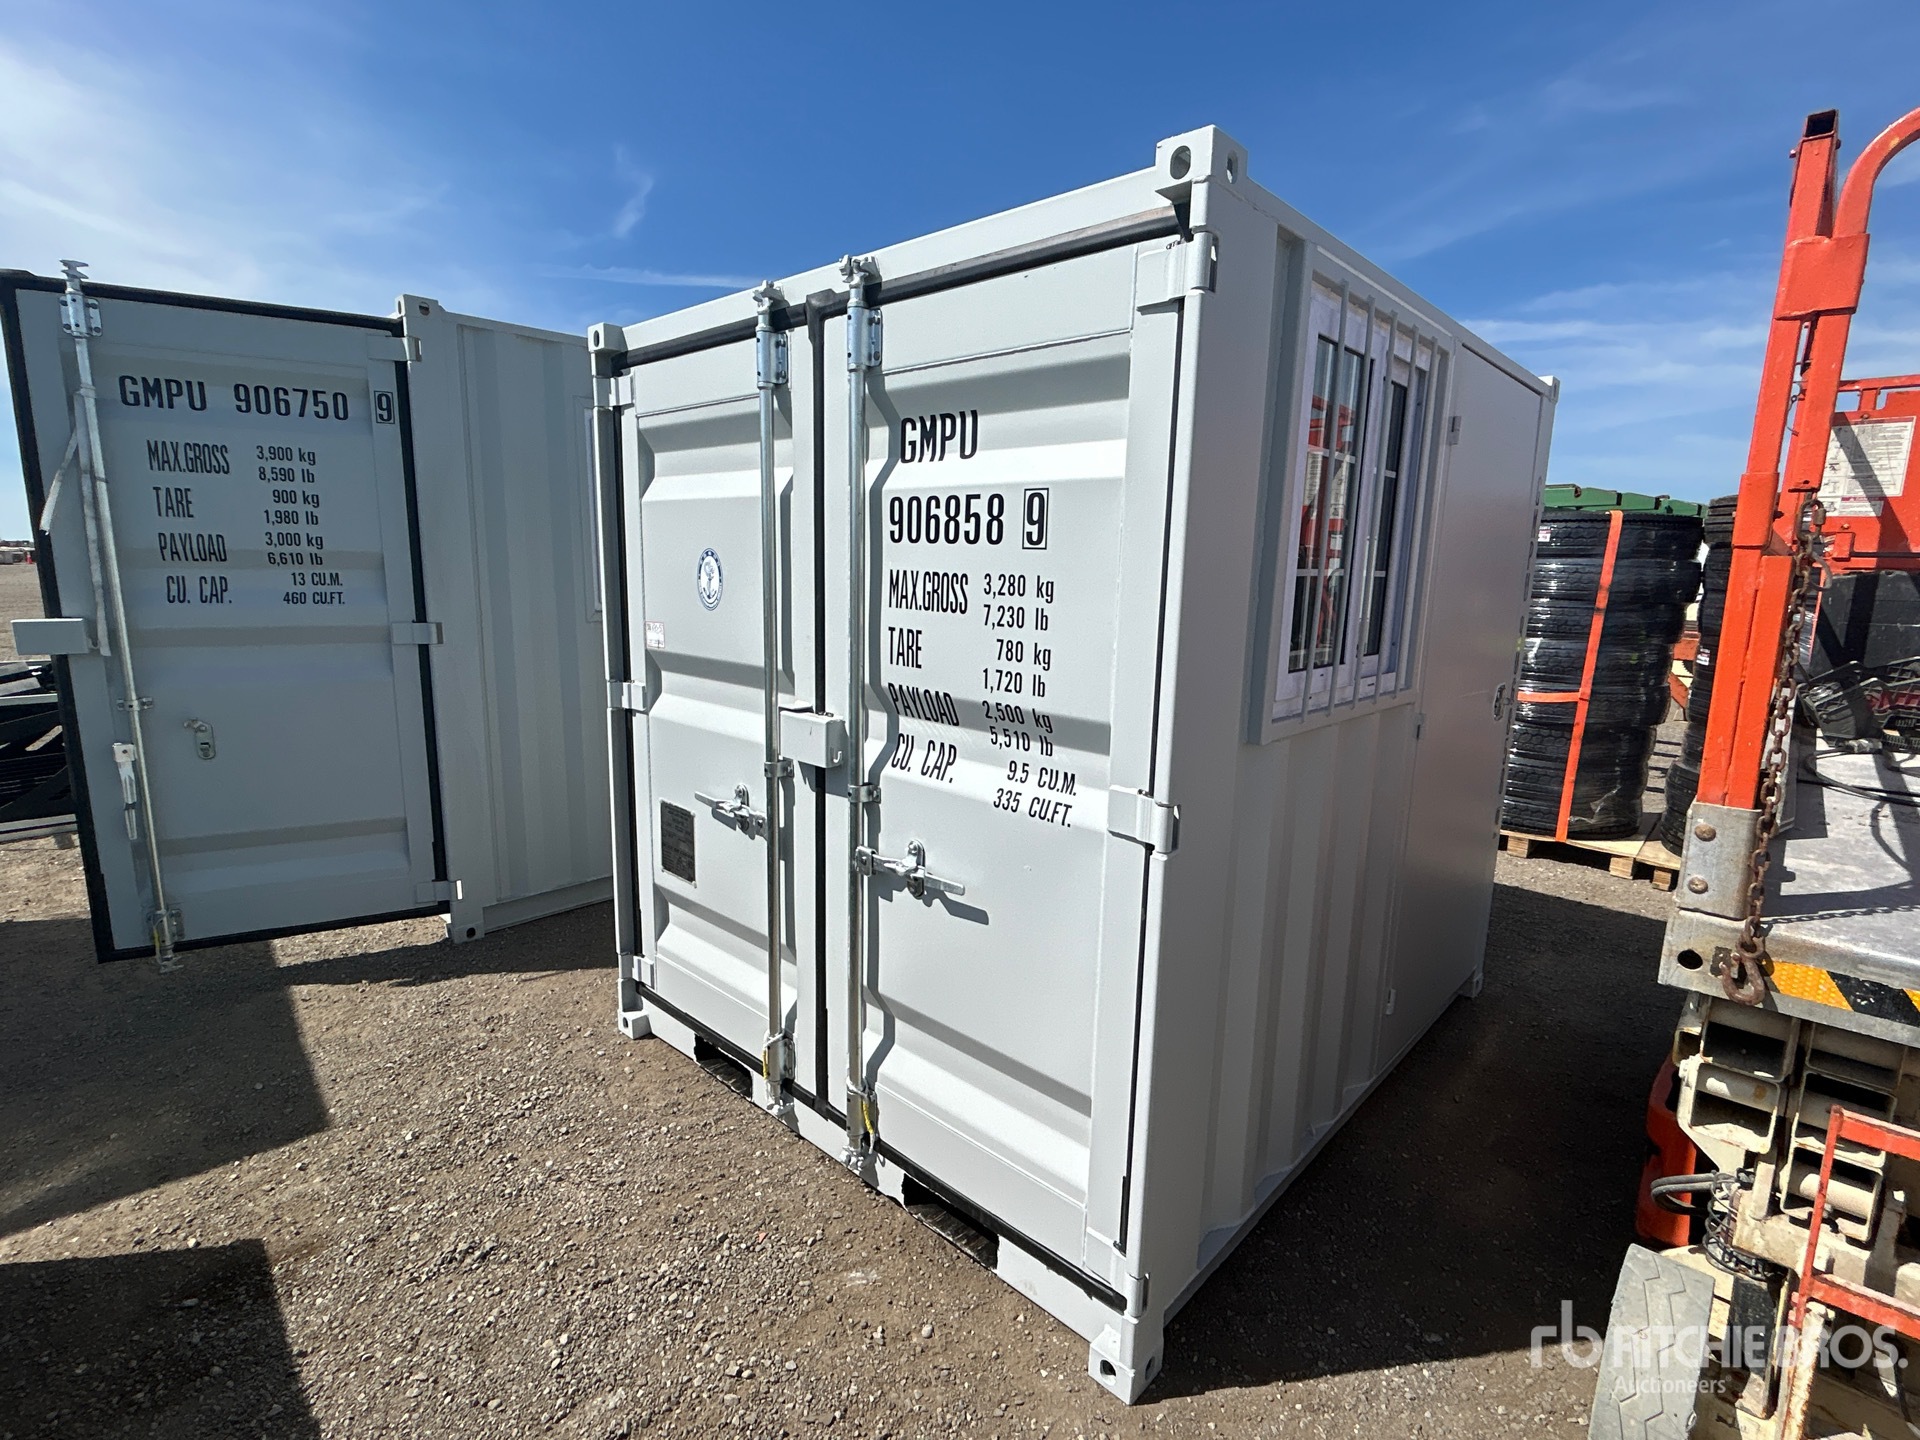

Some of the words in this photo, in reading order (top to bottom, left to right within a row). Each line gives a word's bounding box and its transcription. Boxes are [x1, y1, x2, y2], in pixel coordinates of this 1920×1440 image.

[118, 375, 207, 411] GMPU
[233, 383, 349, 421] 906750
[377, 393, 393, 422] 9
[901, 410, 978, 464] GMPU
[146, 440, 231, 474] MAX.GROSS
[256, 445, 293, 464] 3,900
[299, 448, 316, 465] kg
[258, 466, 295, 484] 8,590
[302, 469, 315, 483] lb
[153, 487, 194, 518] TARE
[272, 490, 297, 504] 900
[302, 491, 320, 508] kg
[264, 510, 299, 527] 1,980
[306, 511, 318, 525] lb
[890, 493, 1005, 545] 906858
[1026, 492, 1045, 546] 9
[158, 533, 227, 562] PAYLOAD
[265, 532, 301, 549] 3,000
[306, 533, 323, 549] kg
[267, 553, 304, 568] 6,610
[311, 553, 323, 566] lb
[165, 576, 190, 604] CU.
[200, 576, 232, 604] CAP.
[291, 573, 306, 586] 13
[311, 573, 343, 587] CU.M.
[283, 592, 307, 605] 460
[312, 592, 345, 605] CU.FT.
[889, 569, 968, 614] MAX.GROSS
[984, 573, 1026, 599] 3,280
[1036, 575, 1054, 603] kg
[984, 604, 1025, 630] 7,230
[1035, 608, 1049, 631] lb
[888, 626, 922, 669] TARE
[997, 639, 1023, 663] 780
[1033, 643, 1051, 671] kg
[983, 668, 1023, 694] 1,720
[1033, 674, 1046, 698] lb
[888, 682, 960, 727] PAYLOAD
[982, 700, 1025, 725] 2,500
[1032, 708, 1053, 733] kg
[989, 726, 1030, 752] 5,510
[1040, 734, 1053, 756] lb
[890, 733, 914, 772] CU.
[921, 740, 957, 783] CAP.
[1007, 760, 1029, 784] 9.5
[1038, 767, 1077, 796] CU.M.
[993, 788, 1022, 813] 335
[1029, 797, 1072, 828] CU.FT.
